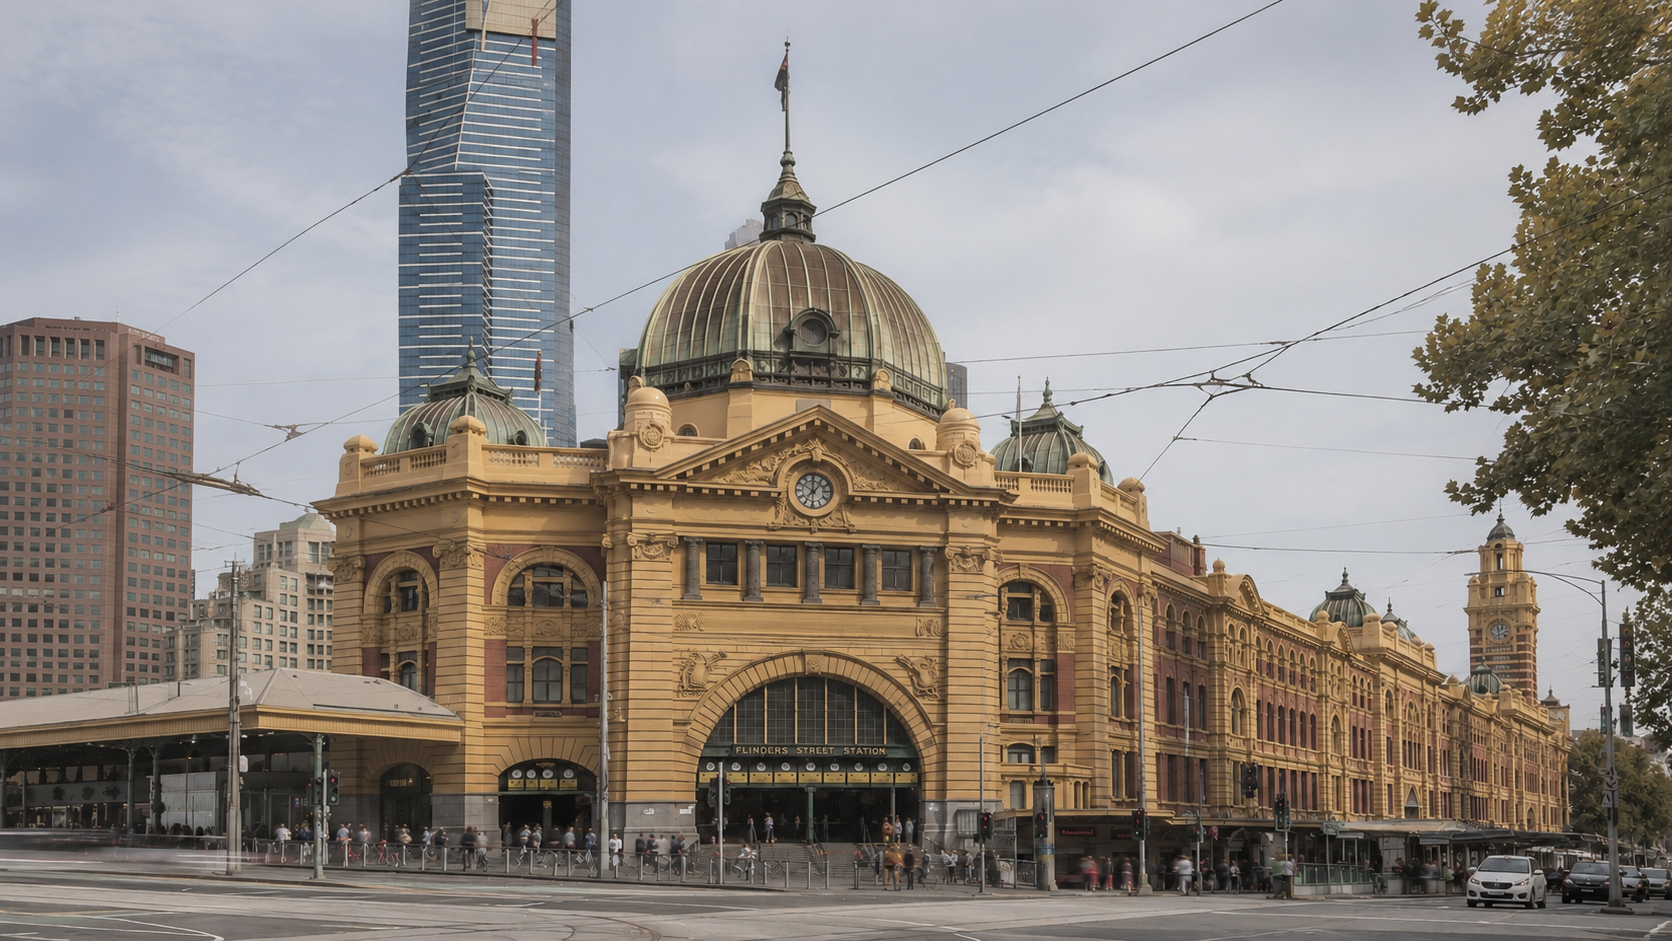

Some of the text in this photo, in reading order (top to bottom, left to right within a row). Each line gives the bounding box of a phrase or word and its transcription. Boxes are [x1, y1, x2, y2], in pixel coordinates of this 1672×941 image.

[735, 746, 887, 755] FLINDERS STREET STATION
